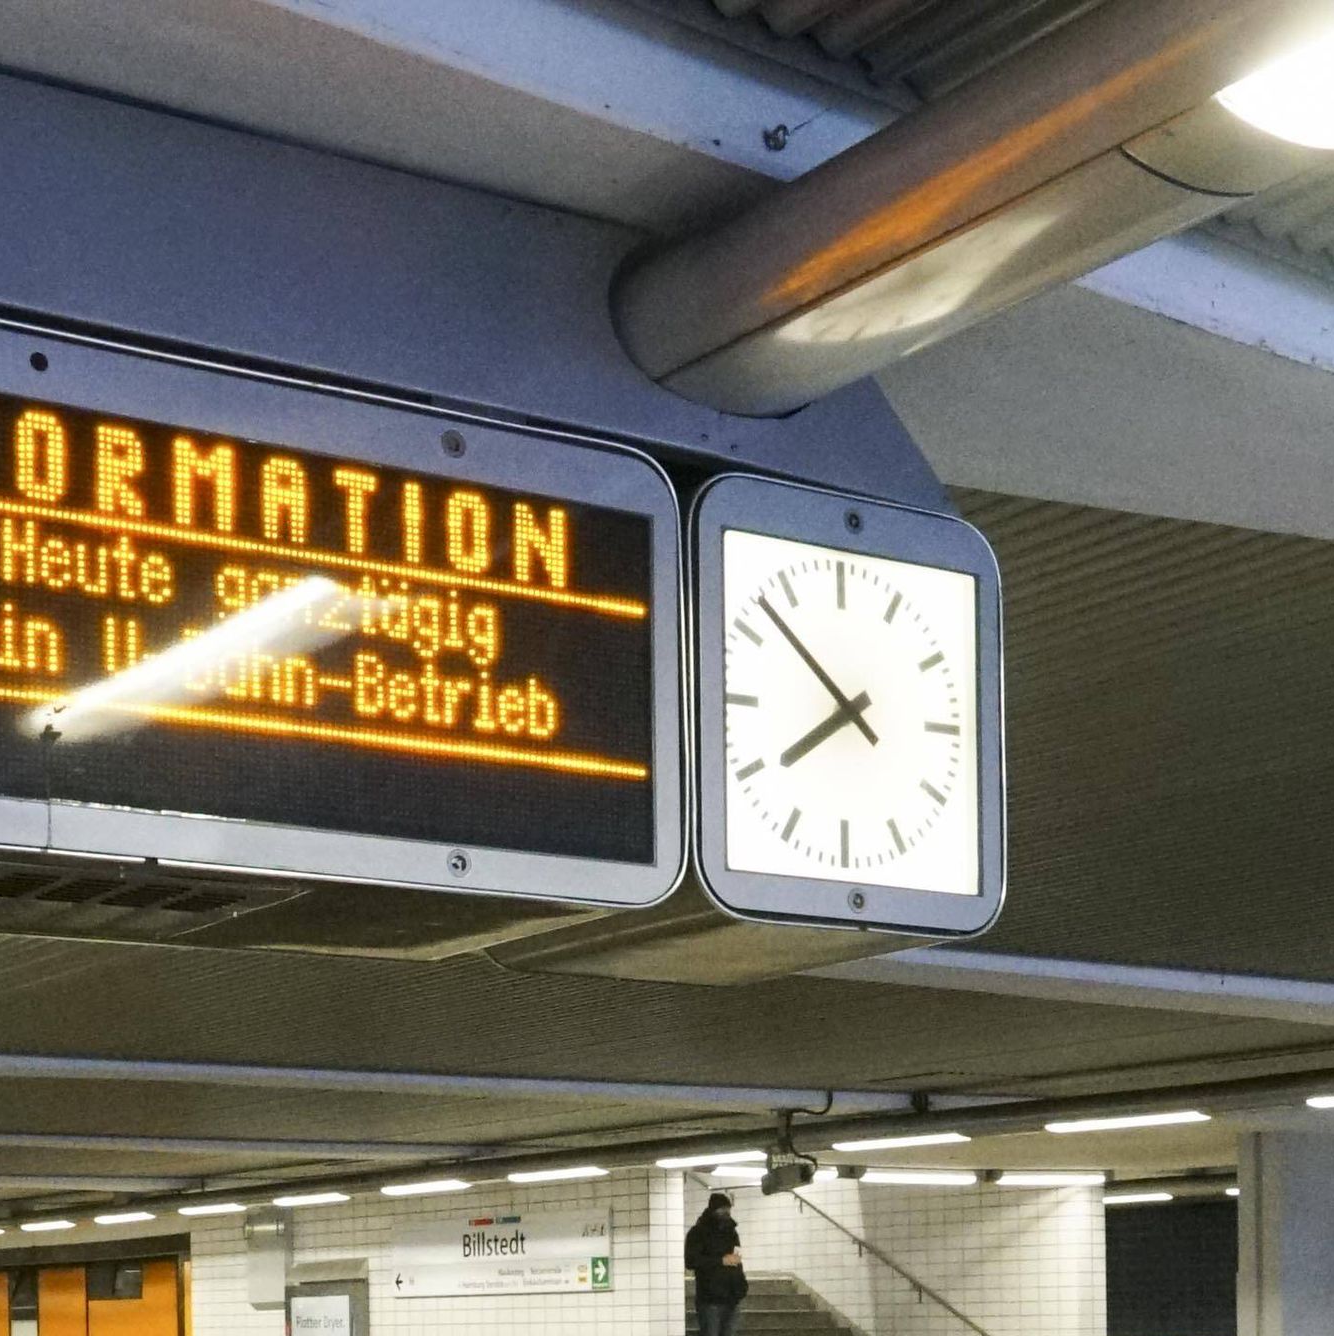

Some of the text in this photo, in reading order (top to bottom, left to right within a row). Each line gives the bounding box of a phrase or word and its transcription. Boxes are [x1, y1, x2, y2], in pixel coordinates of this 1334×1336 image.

[0, 518, 173, 603] Heute
[103, 615, 557, 738] Uahn-Betrieb
[462, 1229, 527, 1258] Billstedt
